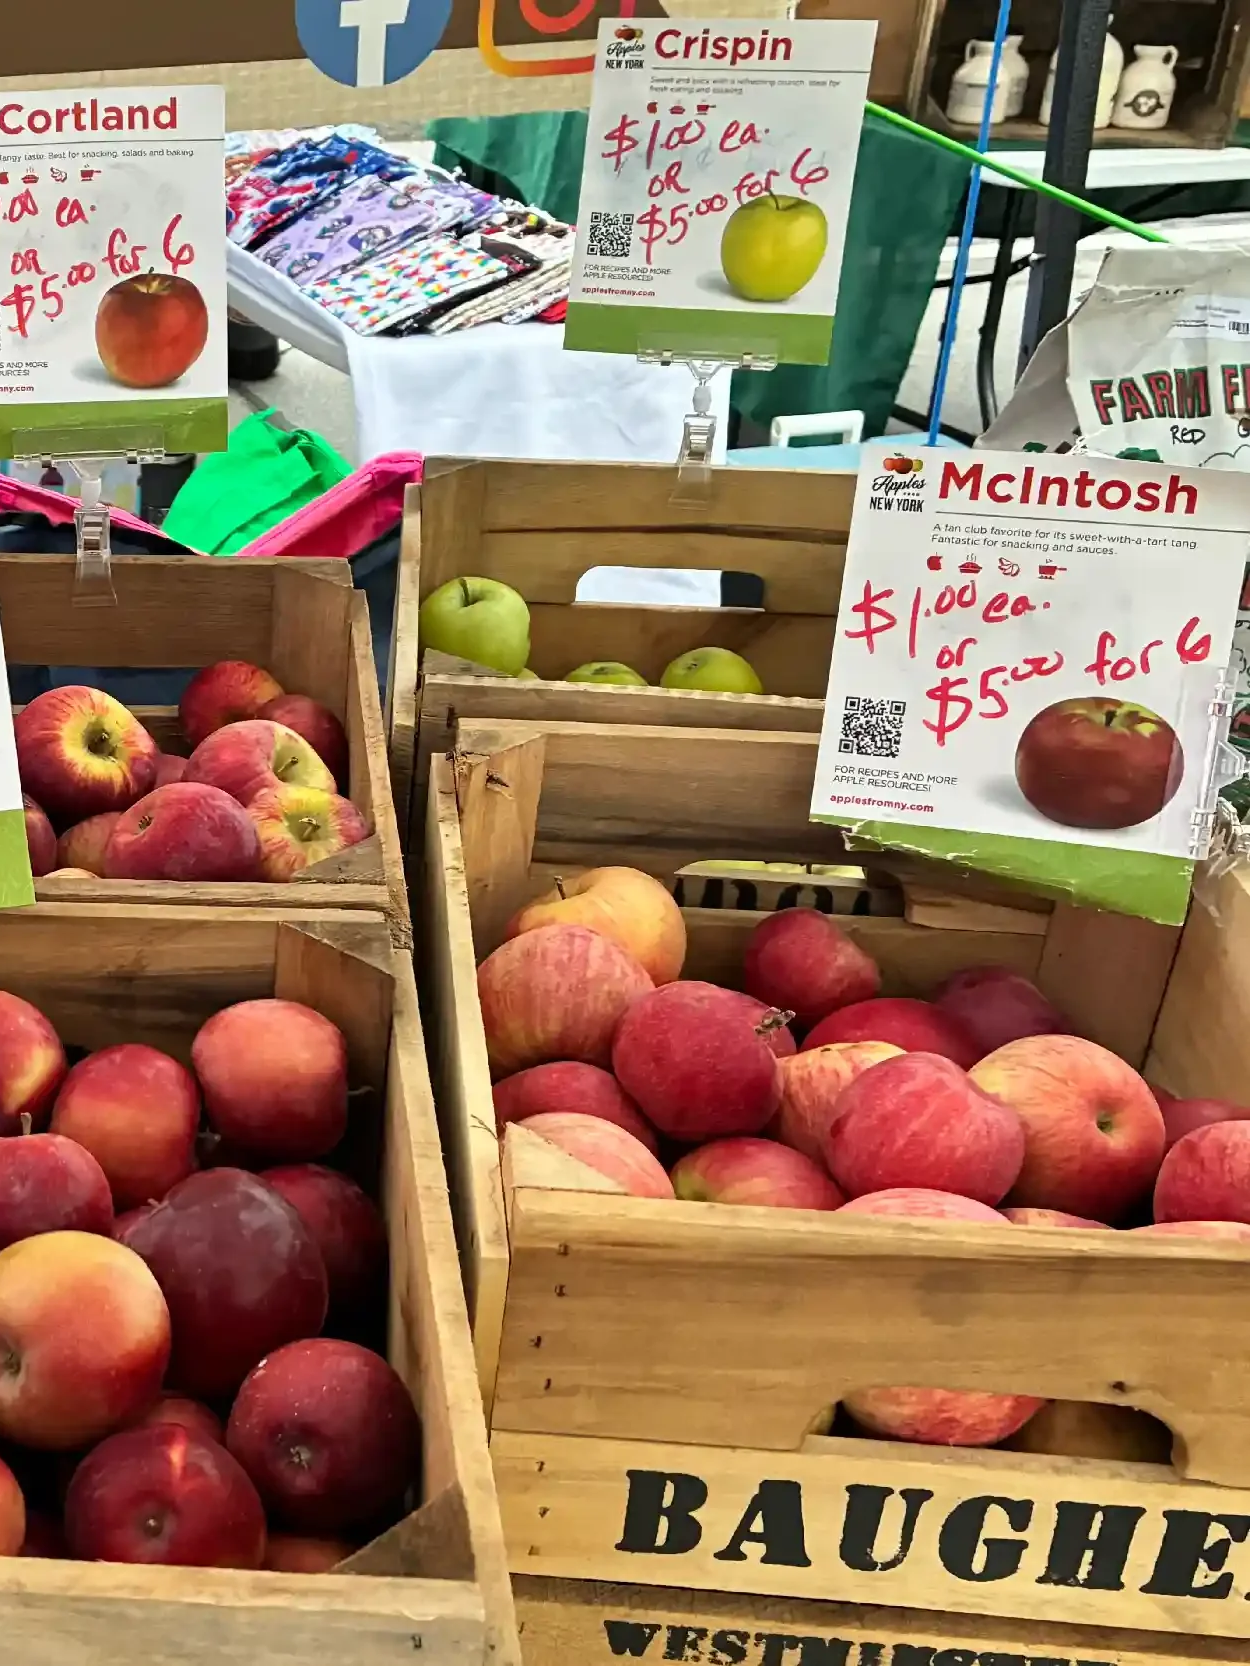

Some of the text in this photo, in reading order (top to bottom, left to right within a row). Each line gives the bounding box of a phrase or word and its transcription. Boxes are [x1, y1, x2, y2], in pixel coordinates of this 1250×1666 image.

[607, 40, 646, 57] Apples
[654, 28, 793, 65] Crispin
[606, 60, 645, 69] NEW YORK
[48, 152, 67, 160] Best
[68, 151, 80, 159] for
[148, 149, 165, 157] and
[601, 113, 770, 172] $1.00 ea.
[55, 196, 97, 228] ea.
[636, 147, 829, 265] $5.00 for 6
[0, 213, 195, 338] $5.00 for 6
[582, 286, 656, 296] applesfromny.com
[1090, 364, 1250, 425] FARM F
[1170, 424, 1206, 445] RED
[872, 474, 926, 496] Apples
[938, 461, 1198, 515] McIntosh
[870, 496, 924, 512] NEW YORK
[931, 534, 1118, 555] Fantastic for snacking and sauces.
[933, 523, 942, 532] A
[942, 524, 962, 532] fan
[964, 525, 988, 534] club
[990, 526, 1032, 538] favorite
[1035, 528, 1051, 539] for
[1053, 530, 1066, 540] its
[1070, 532, 1168, 547] sweet-with-a-tart
[844, 580, 1051, 658] $1.00 ea.
[936, 638, 977, 670] or
[922, 616, 1212, 748] $5.00 for 6
[832, 774, 865, 785] APPLE
[834, 764, 958, 786] FOR RECIPES AND MORE
[830, 794, 934, 812] applesfromny.com
[616, 1470, 1250, 1602] BAUGHE
[603, 1619, 1118, 1666] WESTMIN
